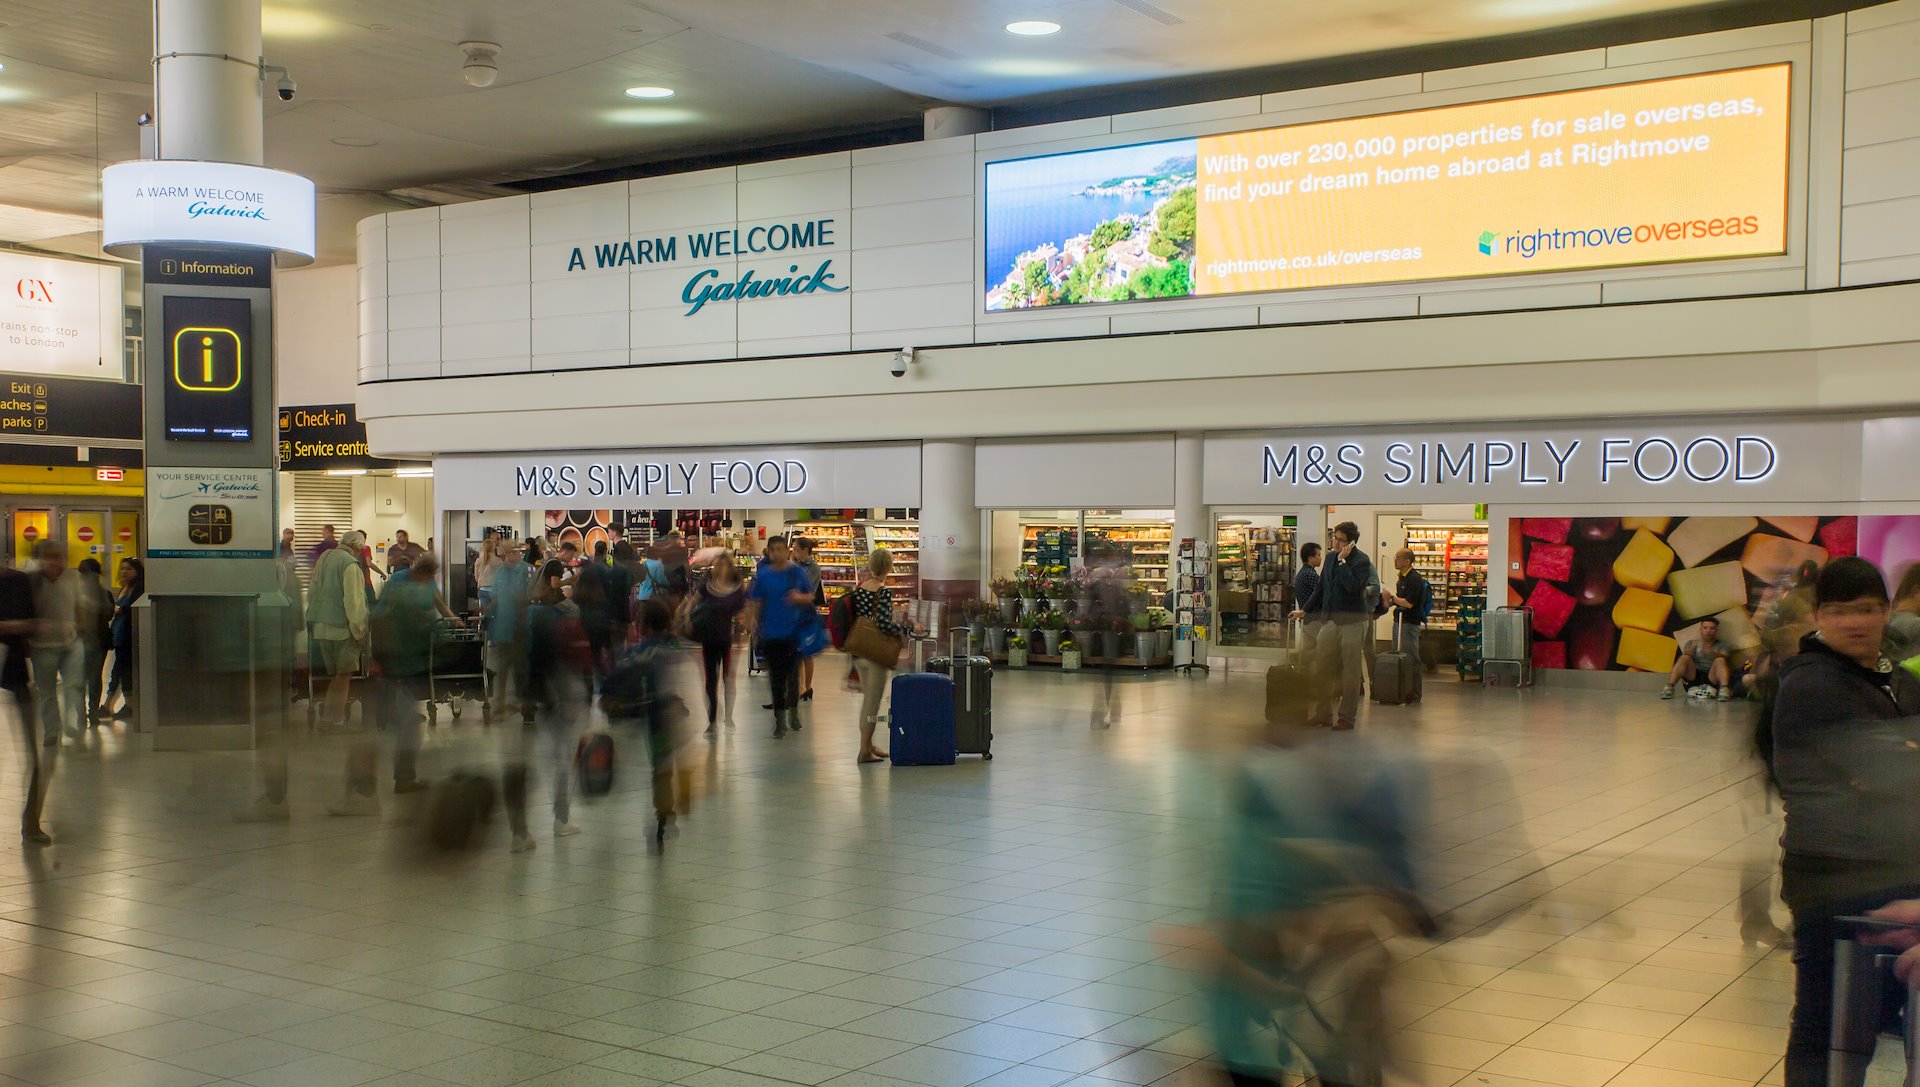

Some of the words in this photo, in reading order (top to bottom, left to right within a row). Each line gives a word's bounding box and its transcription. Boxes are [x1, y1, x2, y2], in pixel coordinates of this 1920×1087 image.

[1204, 153, 1249, 176] With
[1256, 149, 1301, 171] over
[1308, 136, 1396, 165] 230,000
[1402, 122, 1523, 158] properties
[1530, 117, 1566, 140] for
[1573, 109, 1627, 135] sale
[1635, 96, 1764, 128] overseas,
[1203, 182, 1242, 203] find
[1248, 180, 1294, 203] your
[1299, 172, 1369, 194] dream
[1376, 164, 1440, 185] home
[1447, 149, 1530, 178] abroad
[1538, 147, 1563, 168] at
[1571, 131, 1711, 168] Rightmove
[135, 187, 144, 198] A
[148, 186, 189, 198] WARM
[194, 187, 264, 204] WELCOME
[187, 200, 271, 221] Gatwick
[567, 247, 586, 272] A
[594, 236, 677, 269] WARM
[688, 219, 835, 259] WELCOME
[181, 260, 254, 276] Information
[1206, 246, 1423, 280] rightmove.co.uk/overseas
[17, 278, 55, 304] GX
[681, 259, 850, 317] Gatwick
[0, 321, 27, 332] rains
[30, 324, 79, 338] non-stop
[9, 335, 21, 345] to
[25, 336, 65, 349] London
[11, 382, 32, 395] Exit
[0, 398, 32, 412] aches
[2, 416, 32, 429] parks
[295, 409, 346, 428] Check-in
[294, 440, 334, 457] Service
[336, 440, 369, 456] centre
[1262, 443, 1364, 485] M&S
[1383, 440, 1580, 485] SIMPLY
[1600, 437, 1776, 484] FOOD
[156, 473, 181, 481] YOUR
[184, 473, 221, 481] SERVICE
[223, 474, 259, 482] CENTRE
[515, 464, 578, 497] M&S
[588, 462, 700, 497] SIMPLY
[710, 459, 809, 496] FOOD
[213, 482, 263, 493] Gatwick
